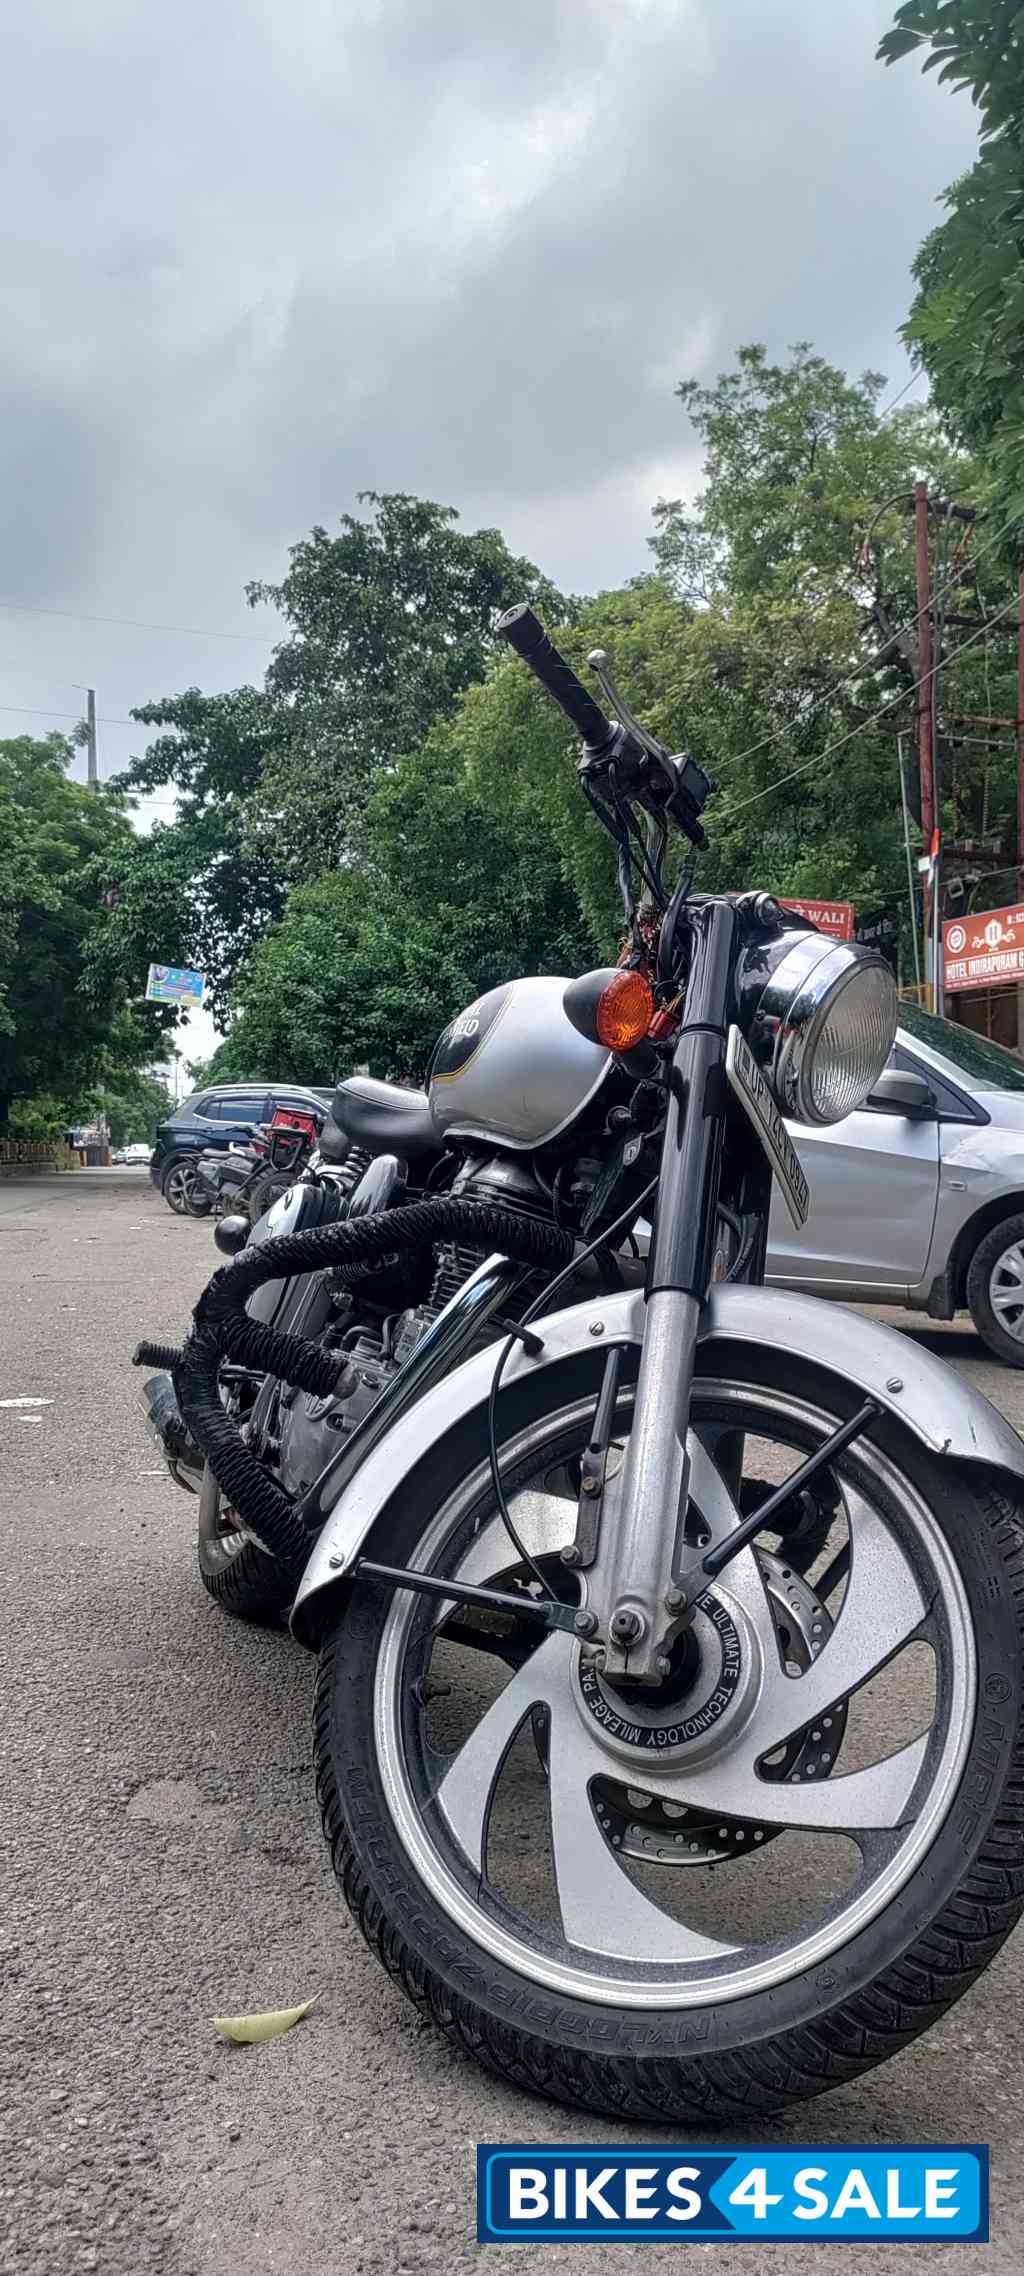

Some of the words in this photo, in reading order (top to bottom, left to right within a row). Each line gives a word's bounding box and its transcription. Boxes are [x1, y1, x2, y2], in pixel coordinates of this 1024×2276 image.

[946, 962, 968, 979] HOTEL
[752, 1062, 766, 1101] UP
[713, 1608, 738, 1678] ULTIMATE
[588, 1696, 642, 1743] MILEAGE
[646, 1686, 733, 1745] TECHNOLOGY
